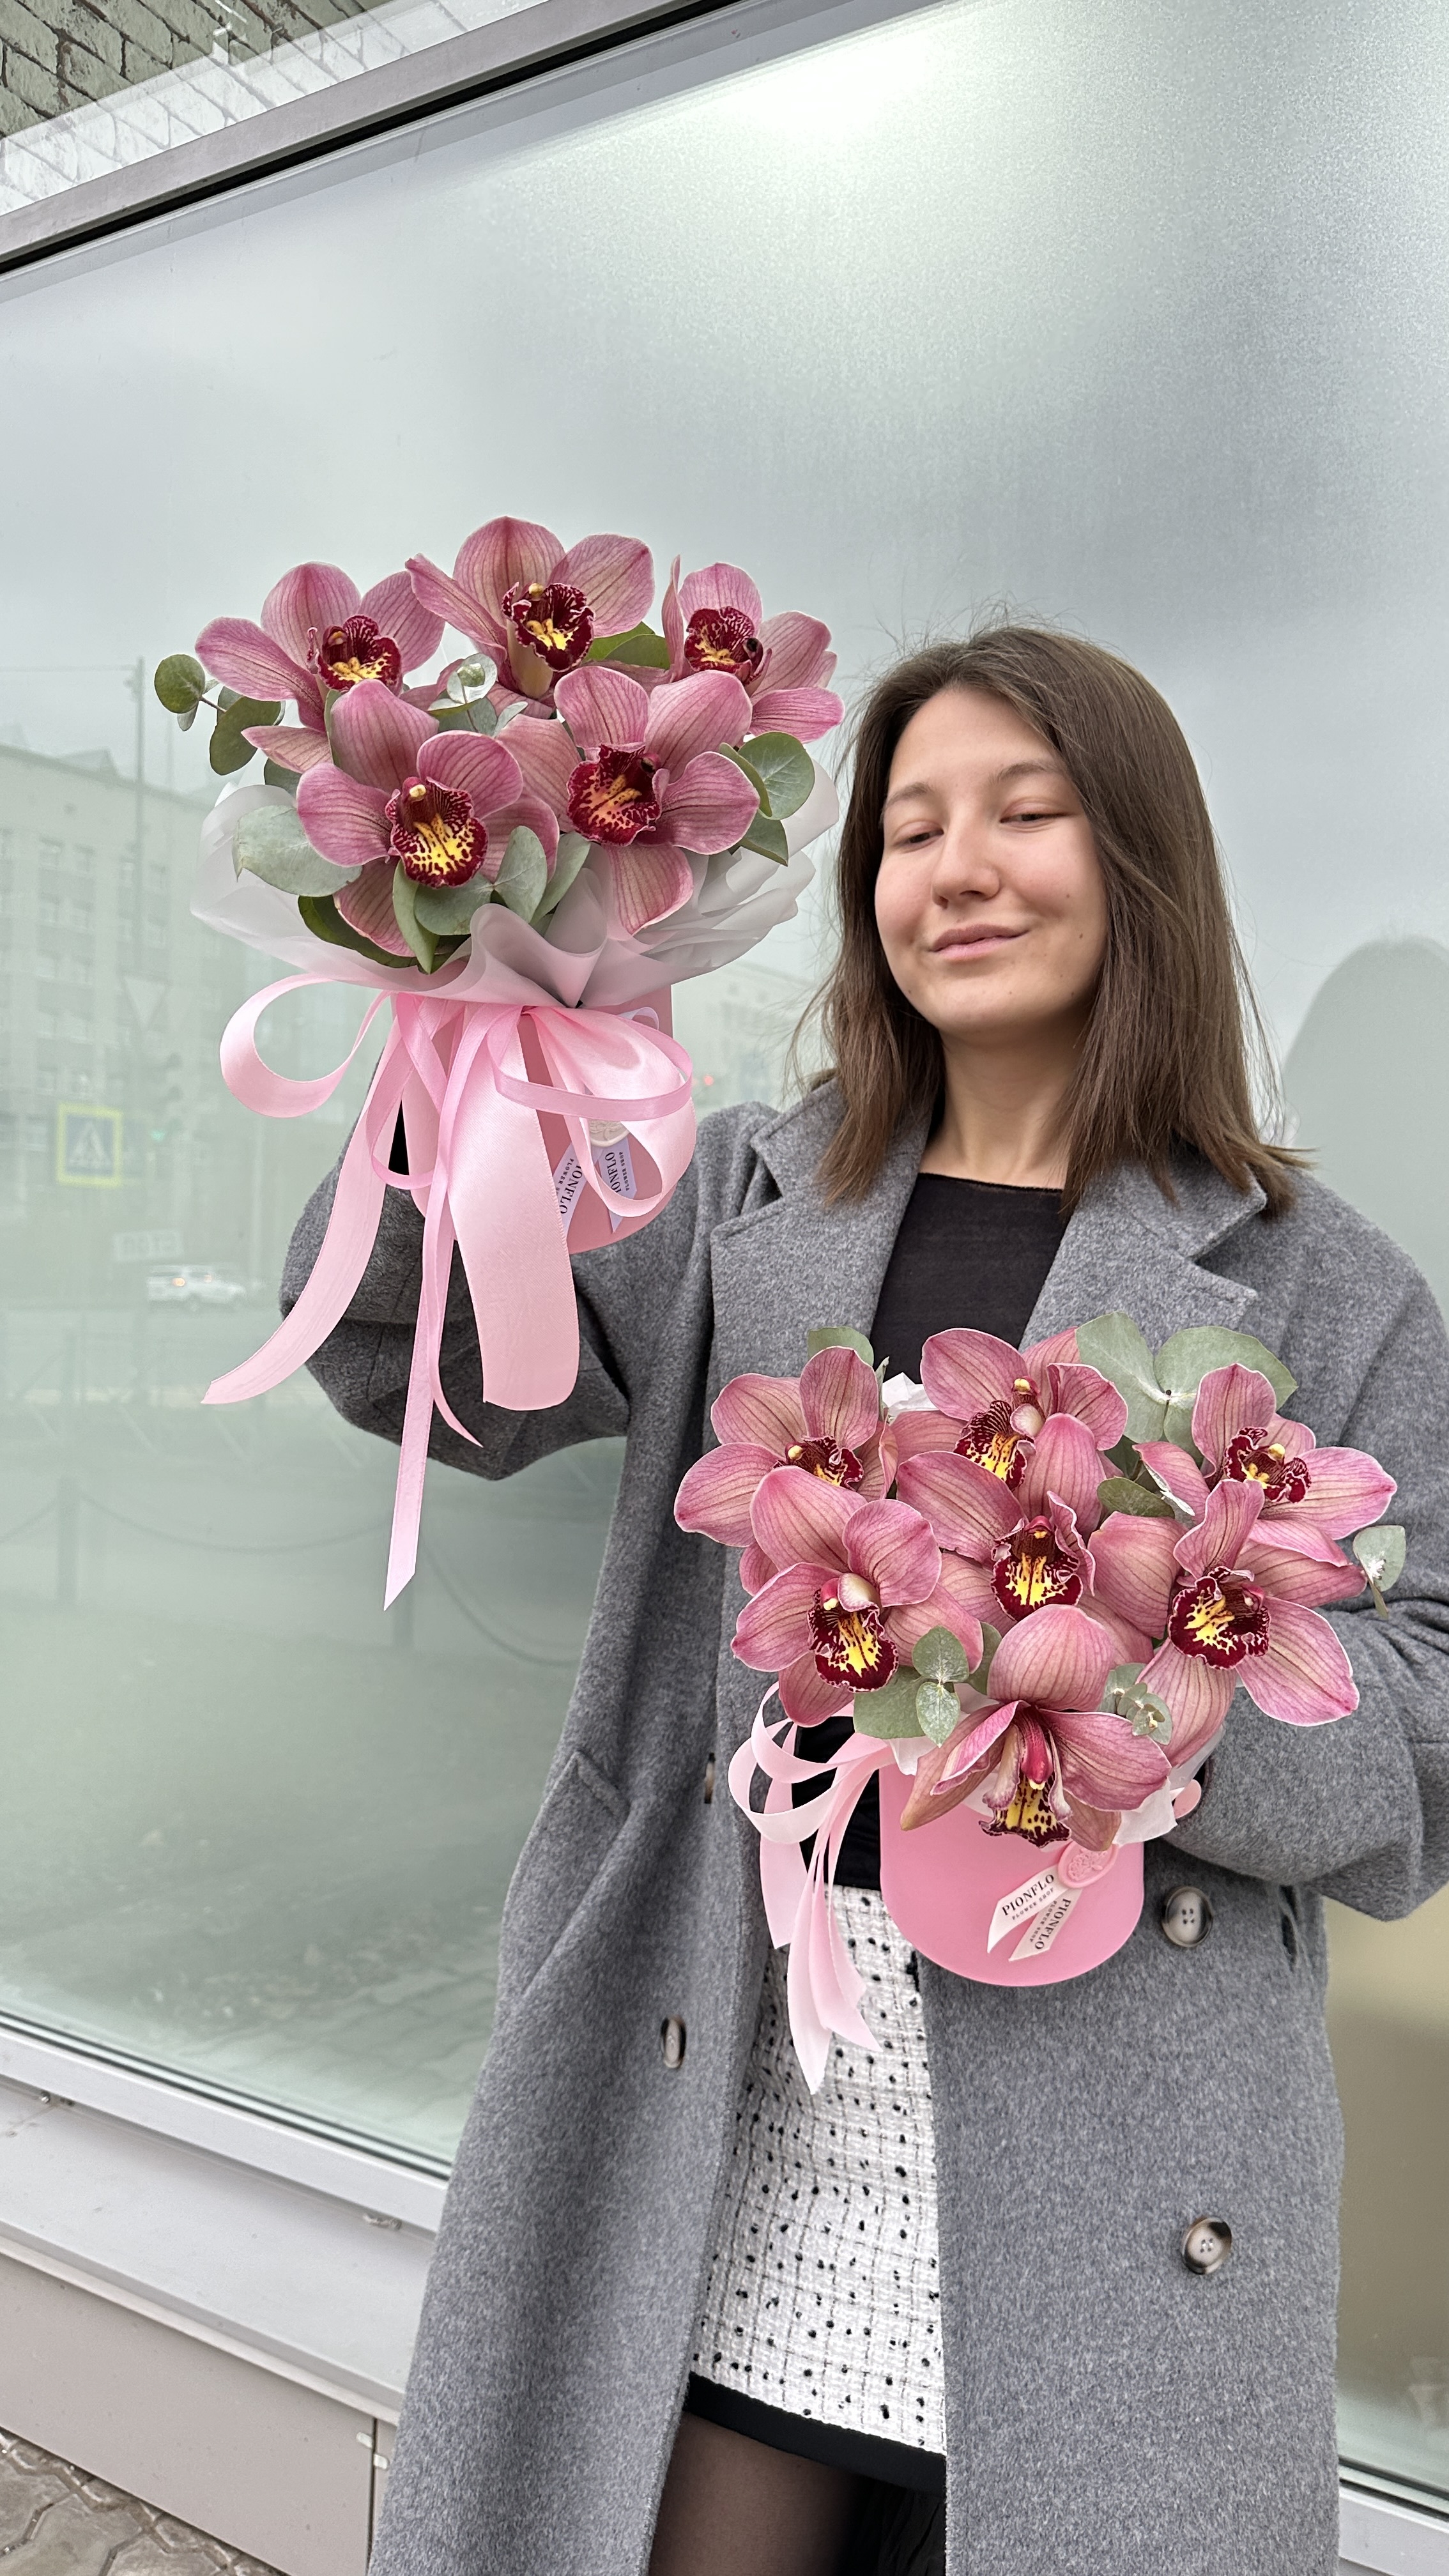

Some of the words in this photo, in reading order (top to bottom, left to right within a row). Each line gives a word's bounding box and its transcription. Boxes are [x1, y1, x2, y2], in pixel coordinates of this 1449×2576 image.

[558, 1158, 574, 1184] FLOWER
[559, 1165, 583, 1215] IONFLO
[604, 1152, 622, 1193] IONFLO
[1002, 1874, 1054, 1916] PIONFLO
[1012, 1901, 1037, 1920] FLOWER
[1034, 1898, 1071, 1950] PIONFLO
